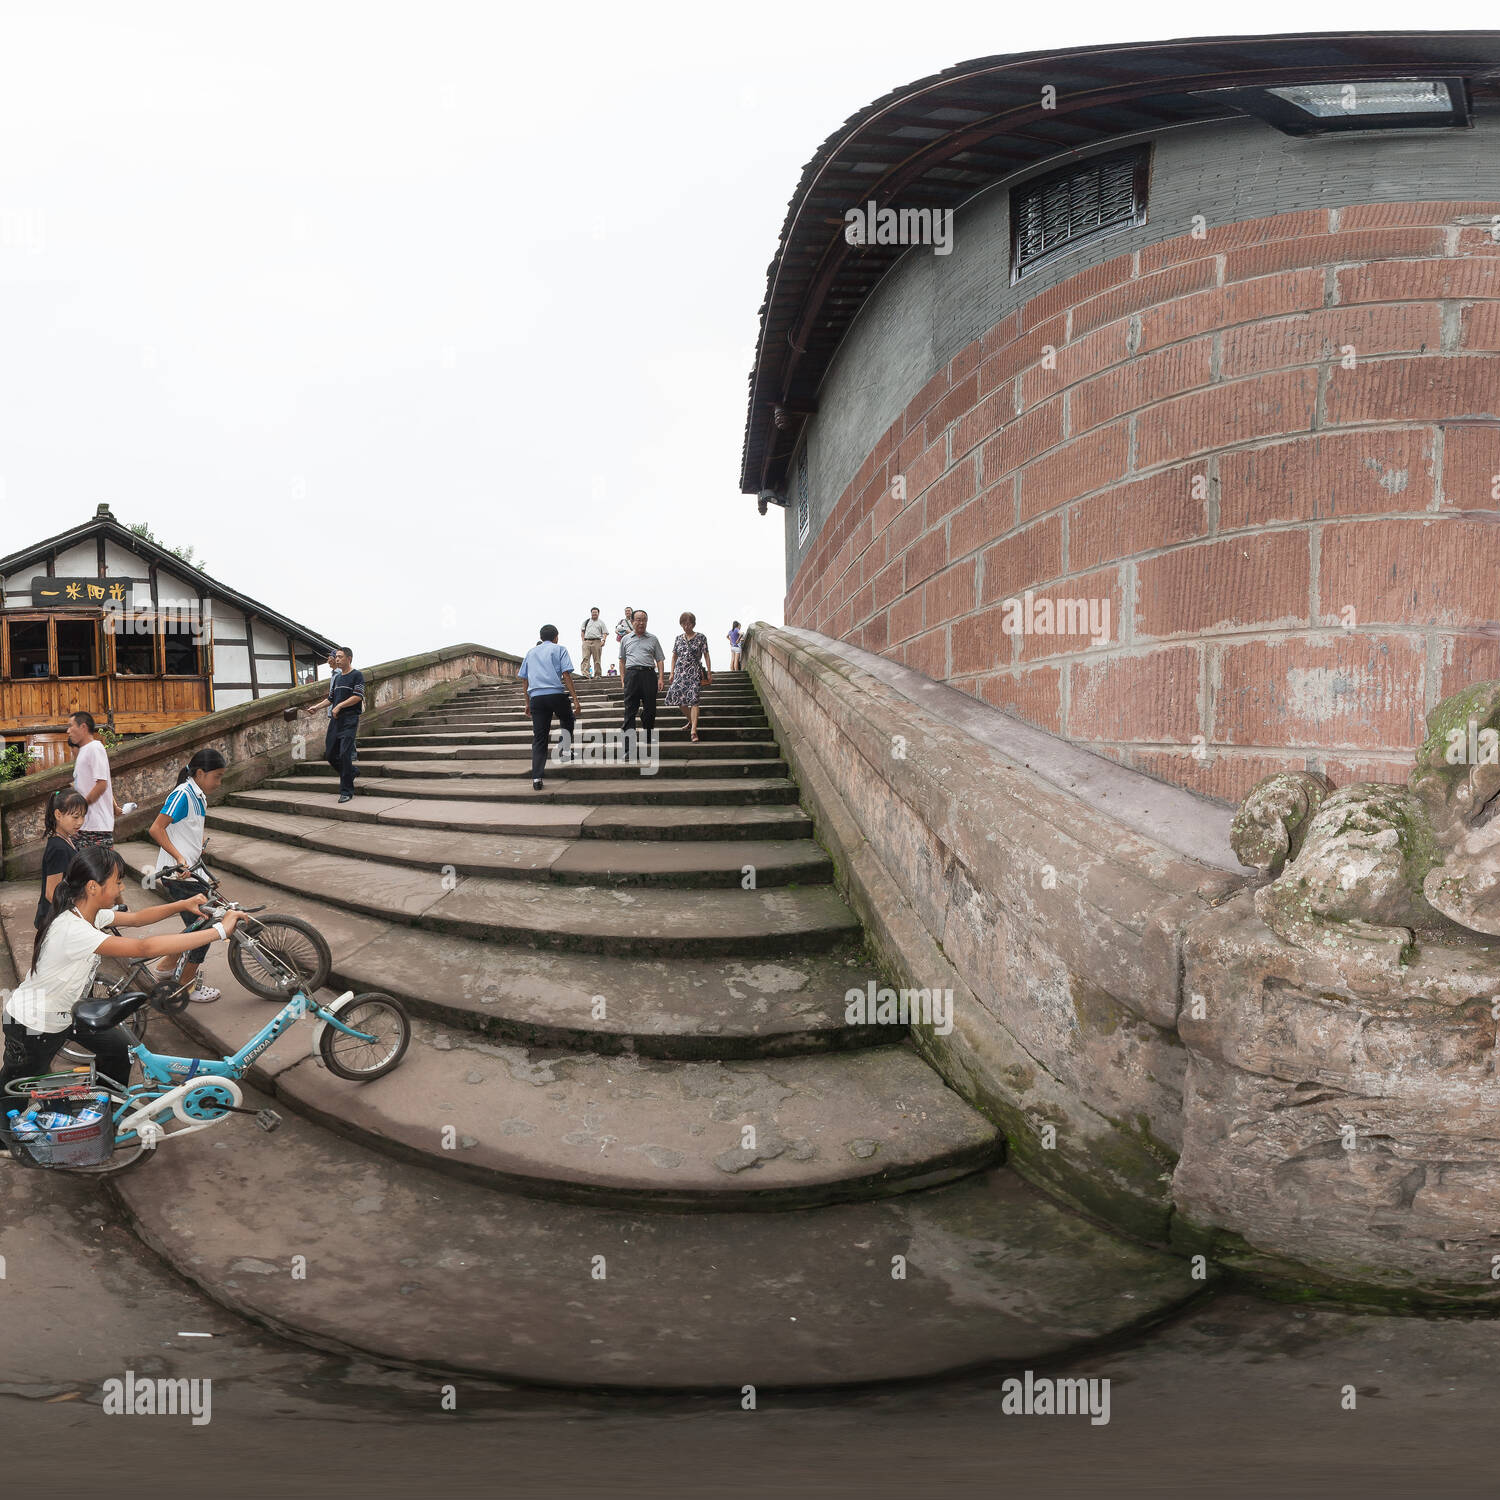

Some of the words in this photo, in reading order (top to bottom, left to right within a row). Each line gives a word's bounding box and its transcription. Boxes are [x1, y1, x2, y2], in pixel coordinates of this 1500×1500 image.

[40, 582, 126, 602] 一米阳光
[243, 1039, 271, 1063] BENDA
